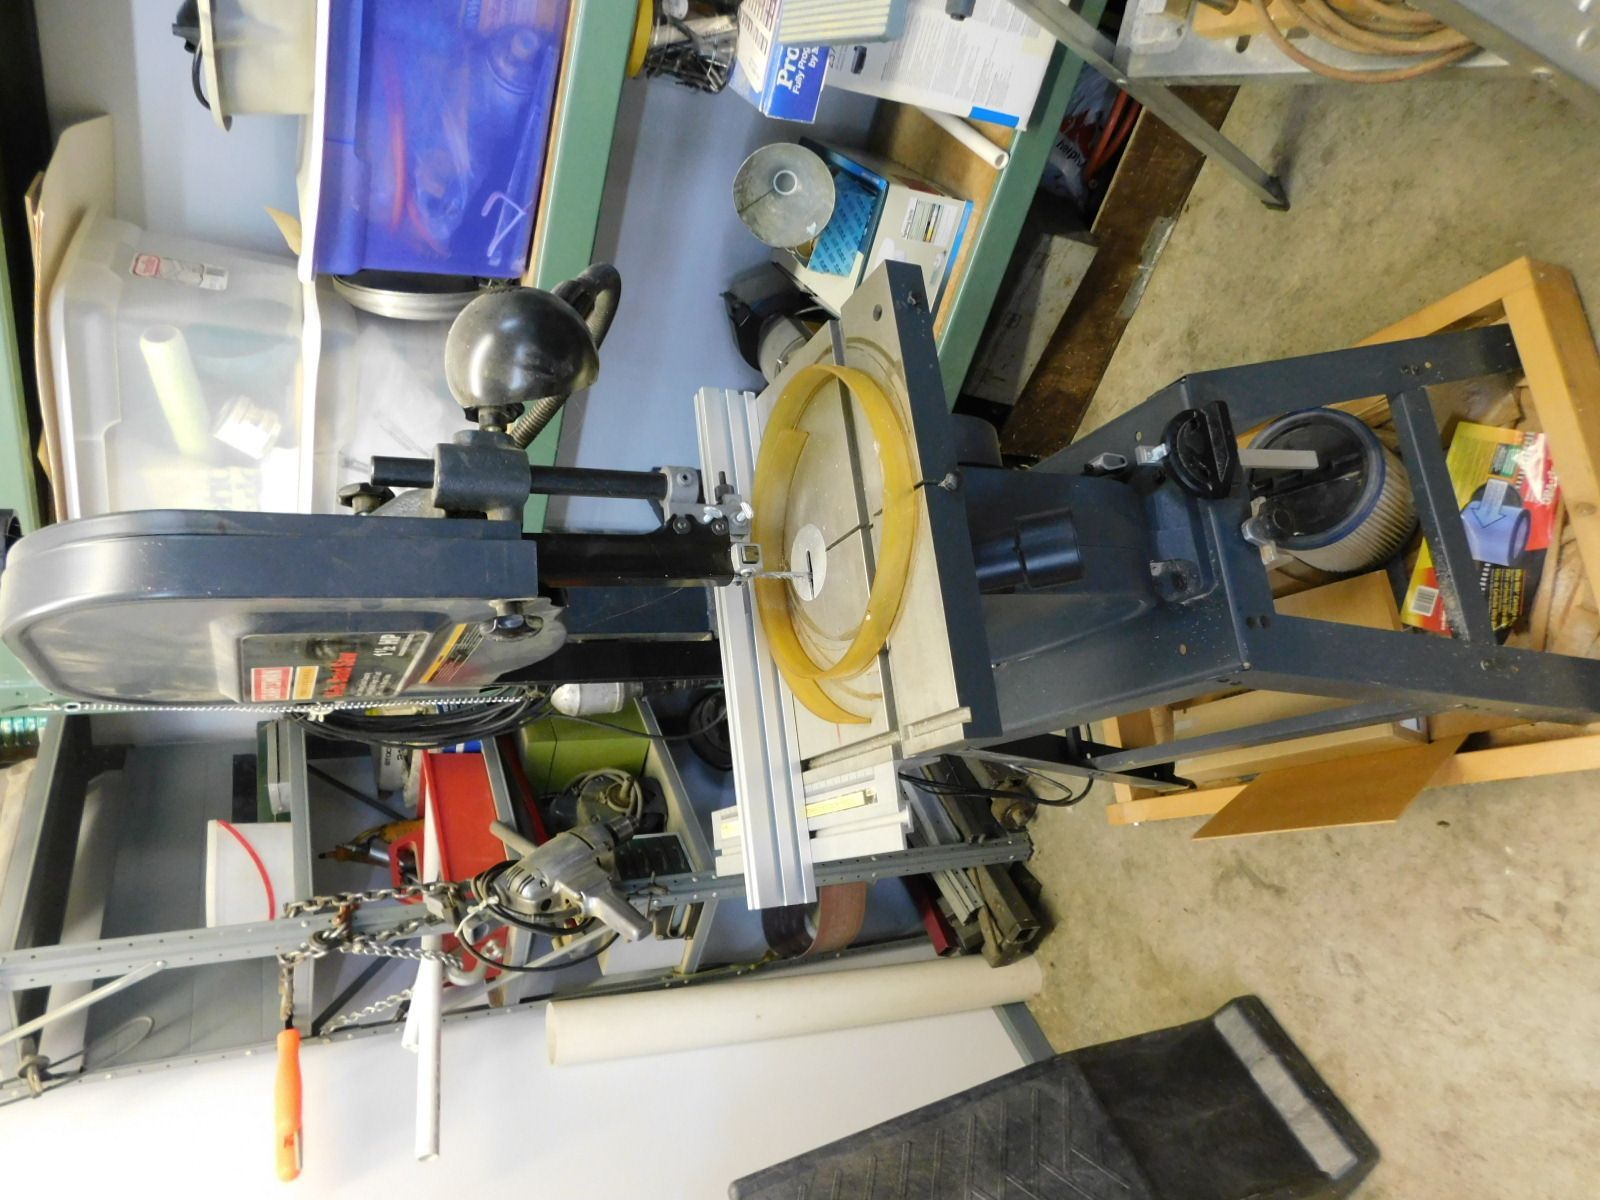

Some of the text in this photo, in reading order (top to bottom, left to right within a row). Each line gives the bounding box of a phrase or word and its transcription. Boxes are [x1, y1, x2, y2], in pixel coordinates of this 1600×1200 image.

[808, 55, 819, 67] by
[792, 71, 805, 94] Fully
[377, 634, 402, 646] HP
